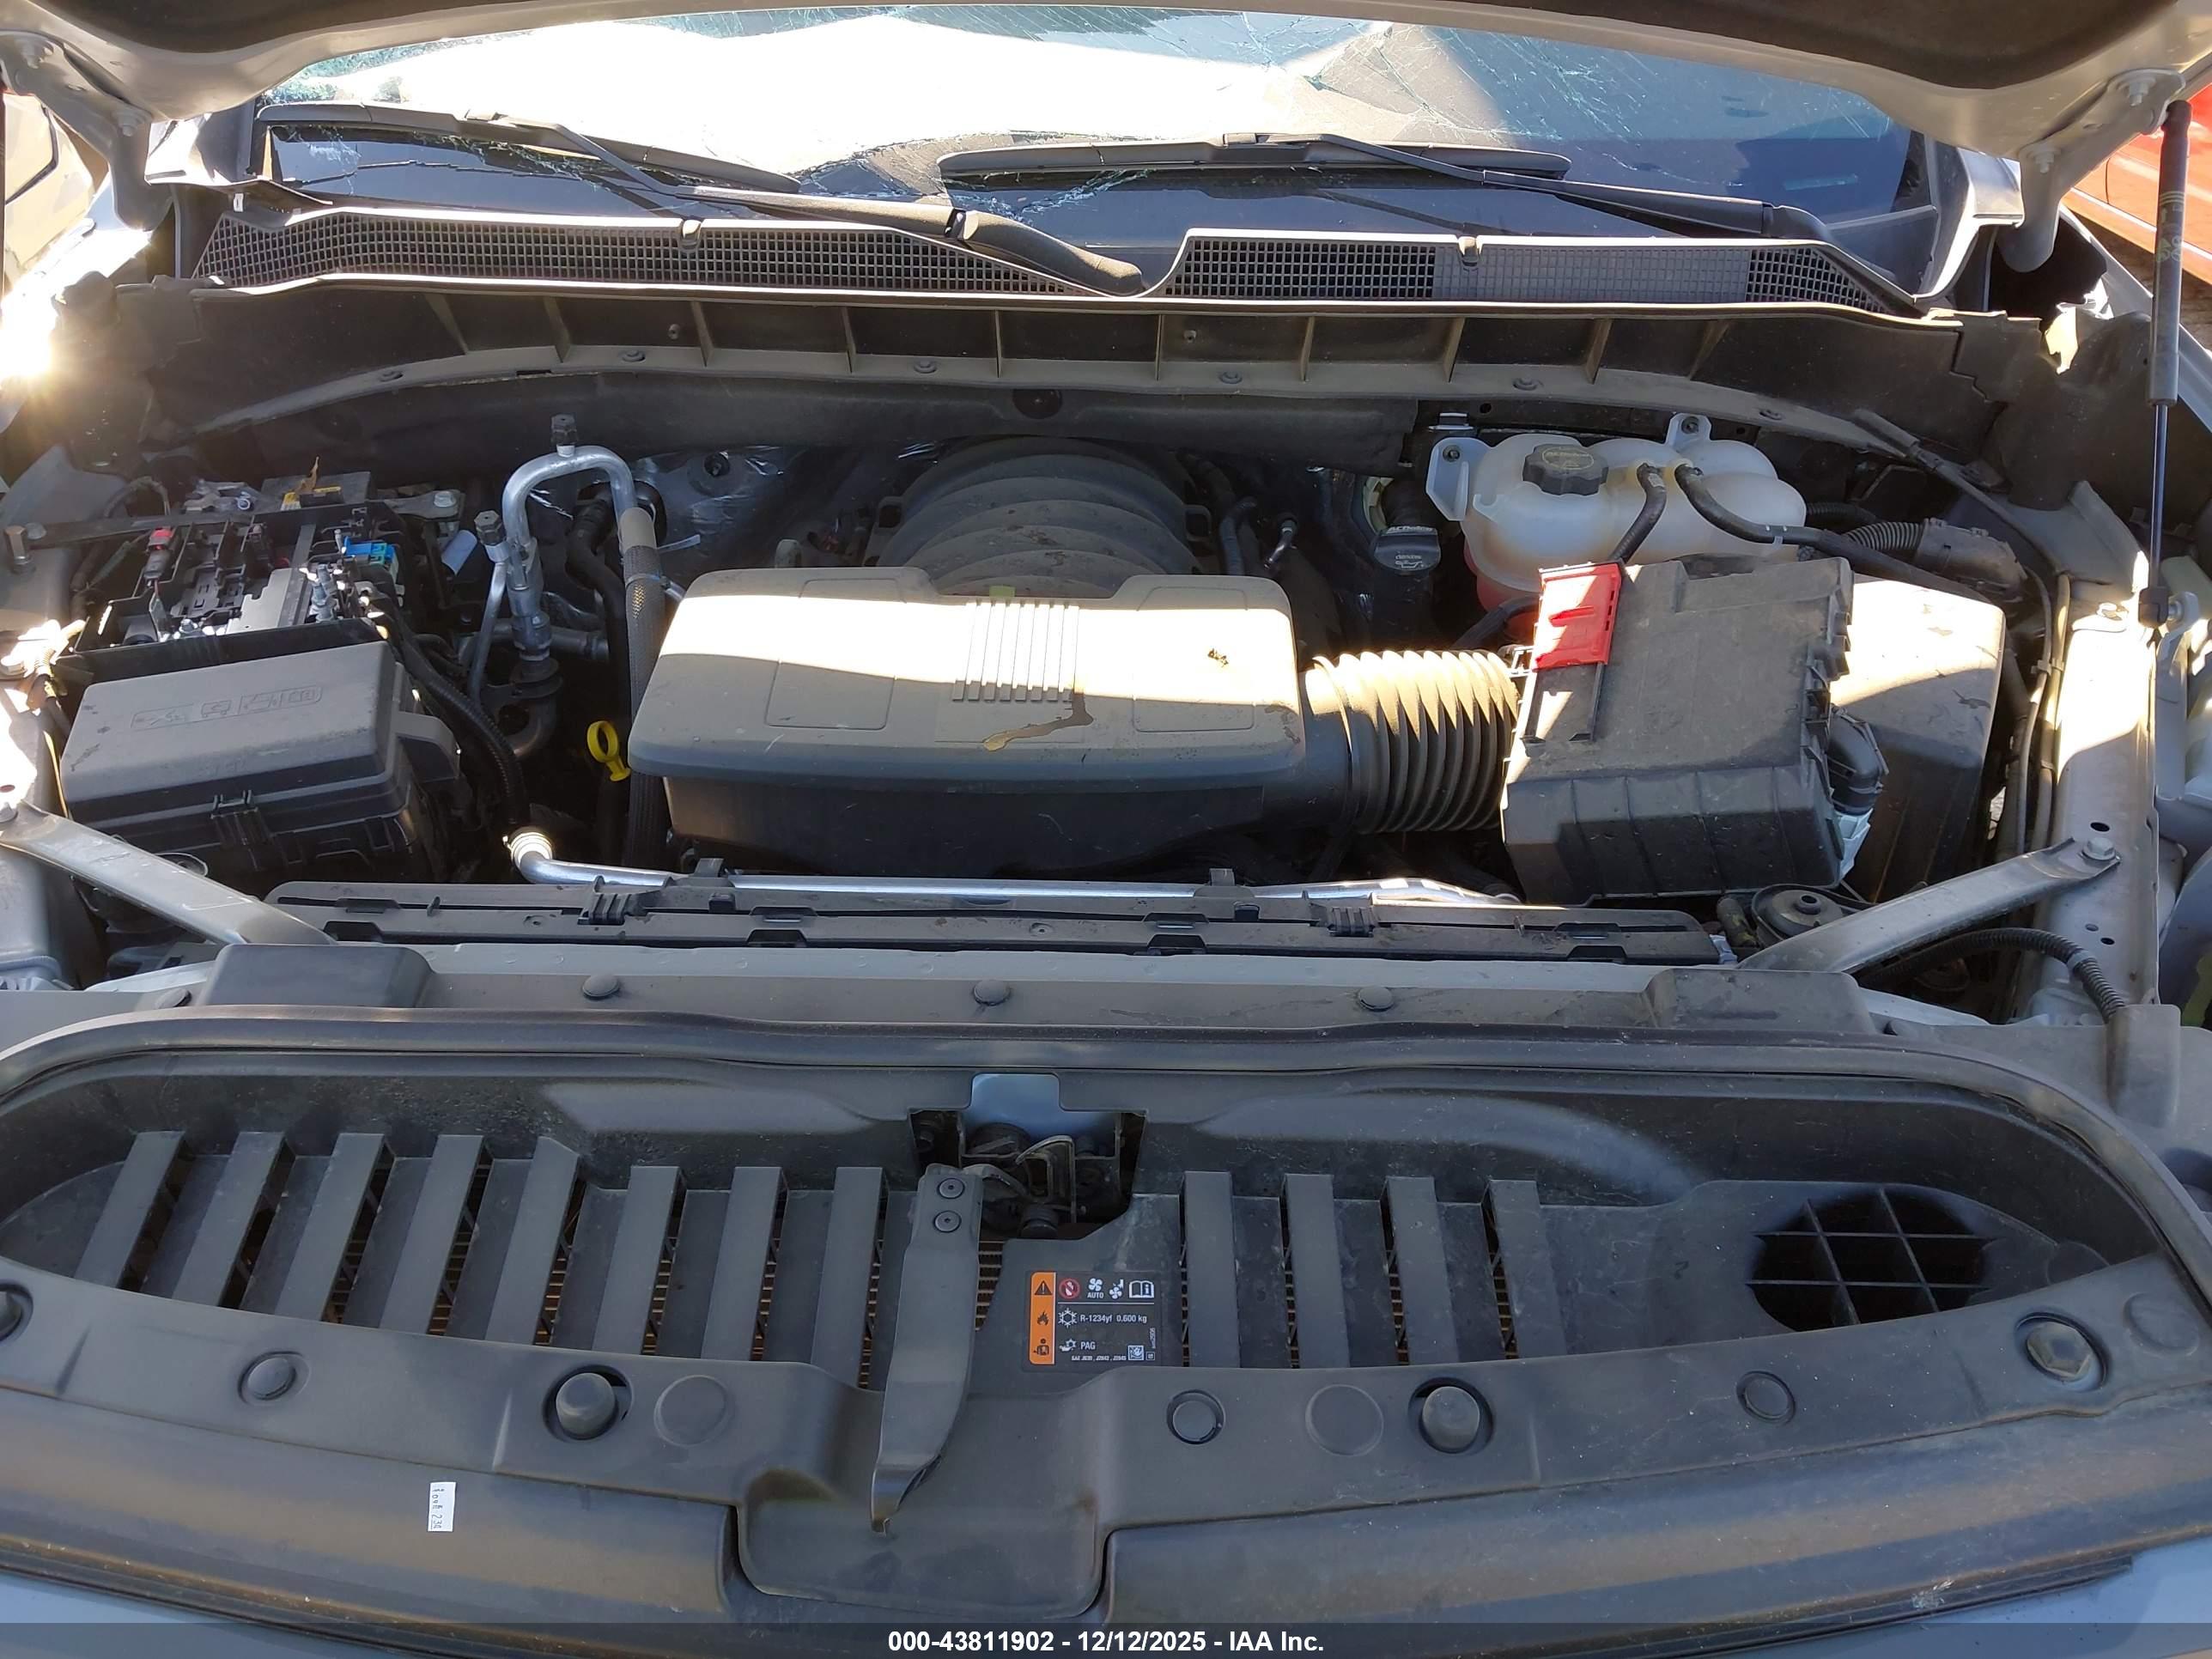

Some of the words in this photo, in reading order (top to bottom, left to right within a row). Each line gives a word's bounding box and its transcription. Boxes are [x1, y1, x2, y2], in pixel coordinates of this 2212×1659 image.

[1080, 1314, 1113, 1324] R-1234yf
[1116, 1314, 1137, 1322] 0.600
[1138, 1314, 1147, 1324] kg
[1080, 1341, 1096, 1350] PAG
